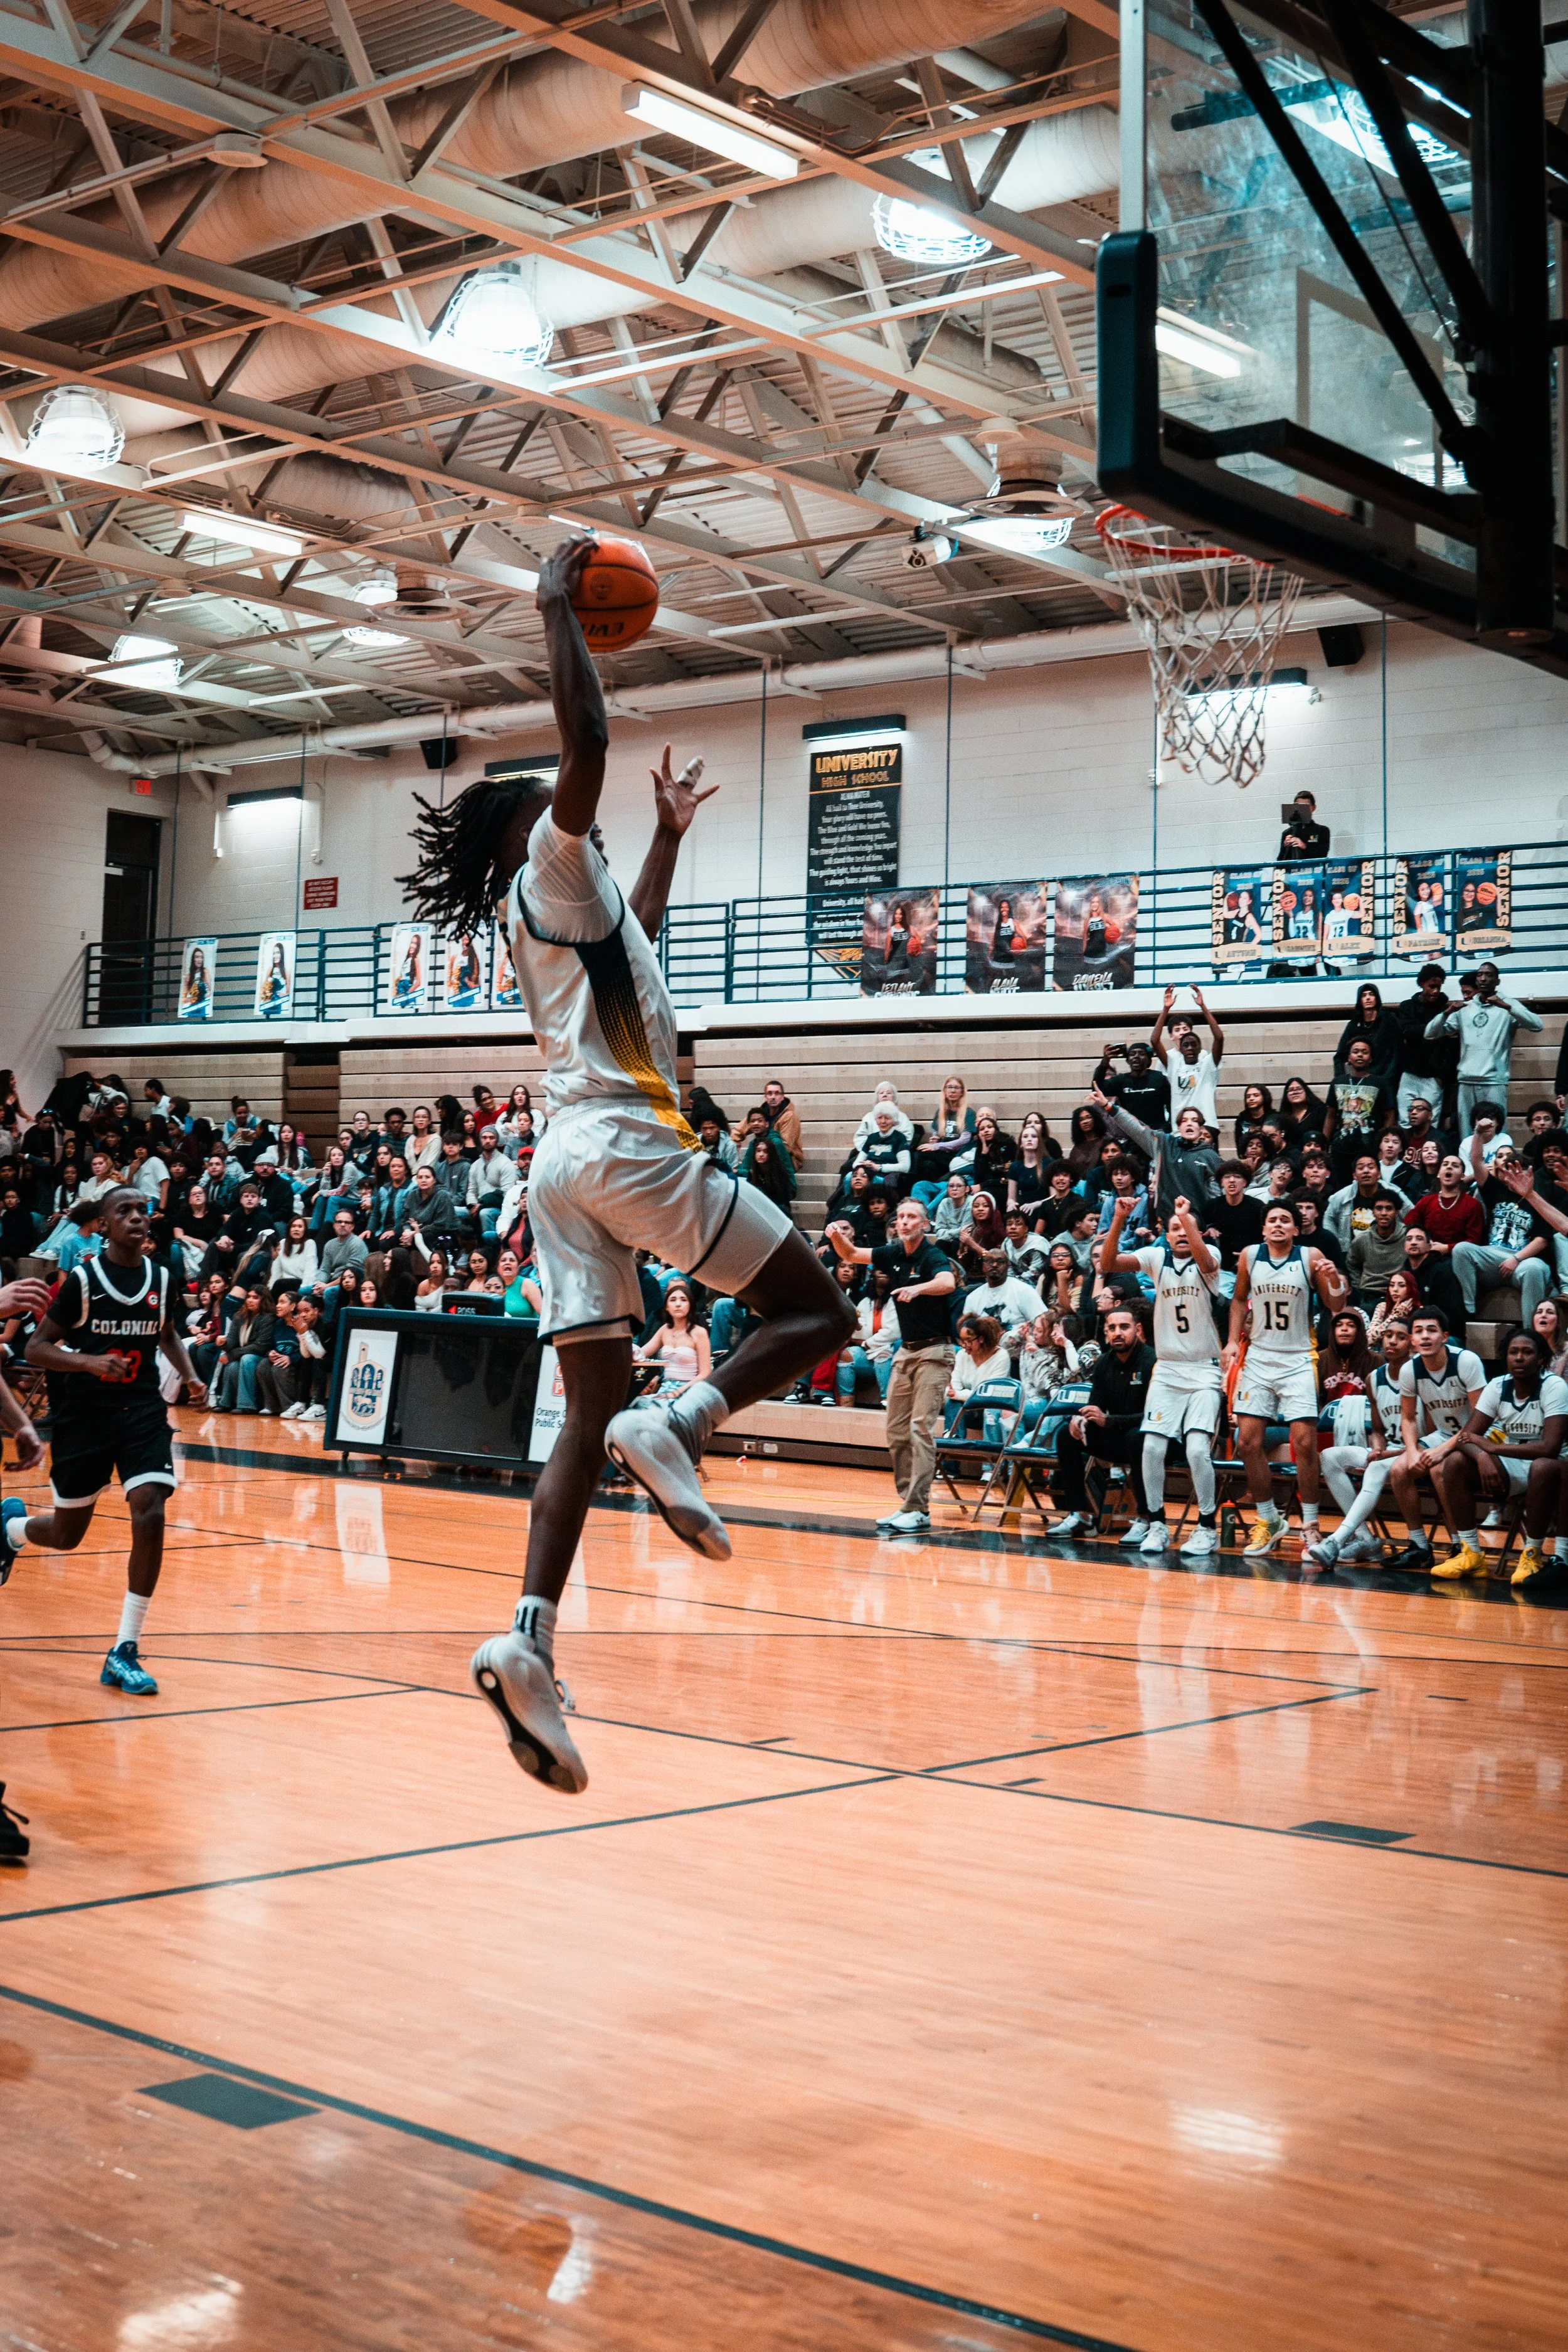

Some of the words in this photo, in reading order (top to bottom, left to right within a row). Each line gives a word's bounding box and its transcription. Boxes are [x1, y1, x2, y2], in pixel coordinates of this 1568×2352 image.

[816, 749, 898, 773] UNIVERSITY
[822, 775, 847, 788] HIGH
[851, 771, 889, 785] SCHOOL
[1360, 860, 1375, 935] SENIOR
[1394, 860, 1409, 935] SENIOR
[1496, 851, 1512, 926] SENIOR
[1212, 872, 1224, 945] SENIOR
[1272, 868, 1286, 941] SENIOR
[1162, 1286, 1199, 1299] UNIVERSITY
[1254, 1284, 1302, 1297] UNIVERSITY
[457, 1306, 476, 1315] POSS
[1175, 1304, 1190, 1333] 5
[1264, 1301, 1289, 1331] 15
[535, 1418, 555, 1428] Public
[536, 1407, 560, 1419] Orange
